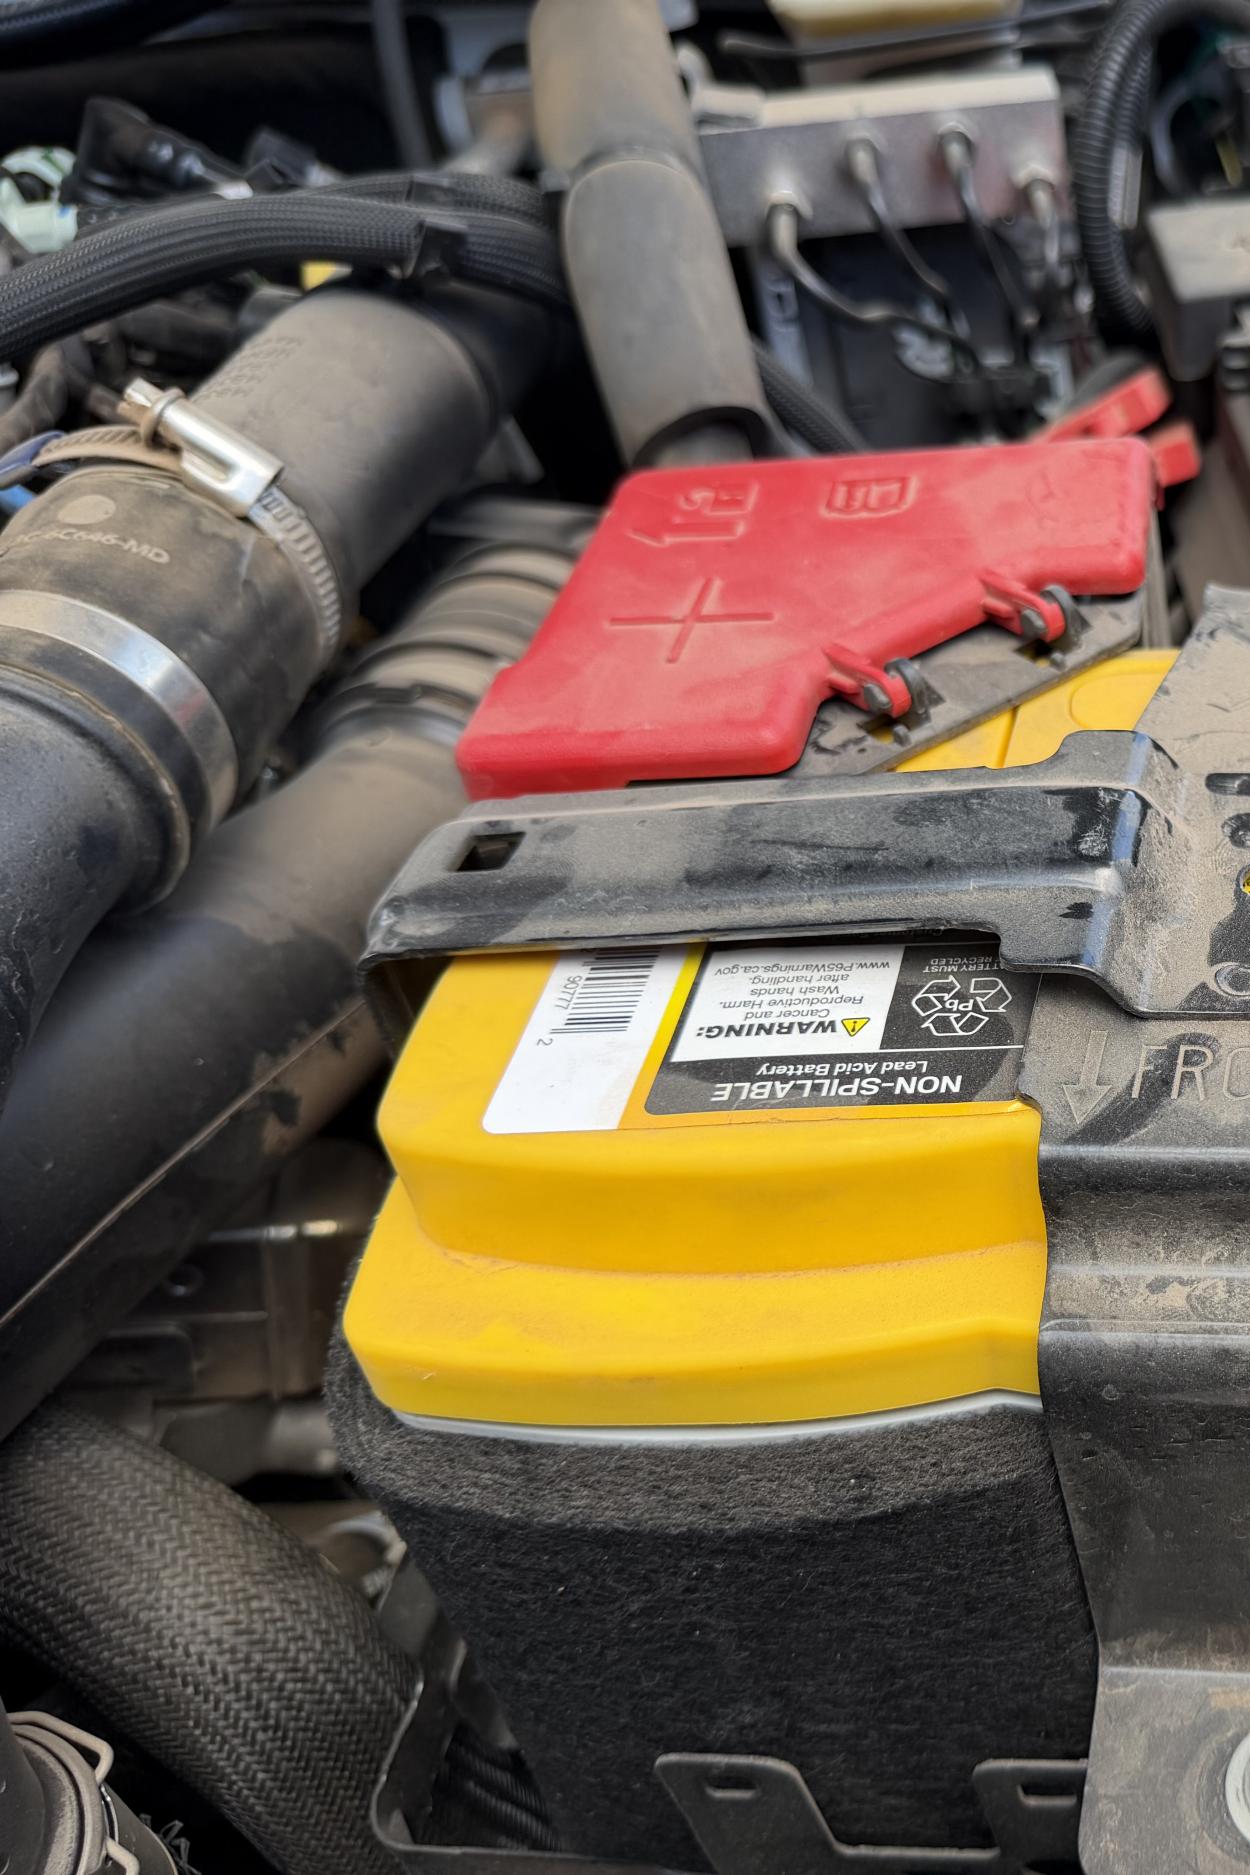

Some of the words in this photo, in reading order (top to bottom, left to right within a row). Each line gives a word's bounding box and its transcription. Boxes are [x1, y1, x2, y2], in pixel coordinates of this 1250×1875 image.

[931, 956, 993, 965] RECYCLED
[715, 961, 890, 976] www.P65Warnings.ca.gov
[923, 964, 958, 973] MUST
[748, 975, 814, 986] handling.
[818, 974, 850, 984] after
[554, 975, 583, 1010] 90777
[750, 987, 796, 998] hands
[800, 986, 839, 996] Wash
[719, 999, 764, 1009] Harm.
[767, 995, 864, 1007] Reproductive
[945, 999, 974, 1011] Pb
[743, 1011, 773, 1022] and
[776, 1009, 831, 1020] Cancer
[696, 1020, 837, 1039] WARNING:
[757, 1062, 831, 1077] Battery
[834, 1062, 879, 1077] Acid
[882, 1060, 928, 1074] Lead
[710, 1074, 963, 1101] NON-SPILLABLE
